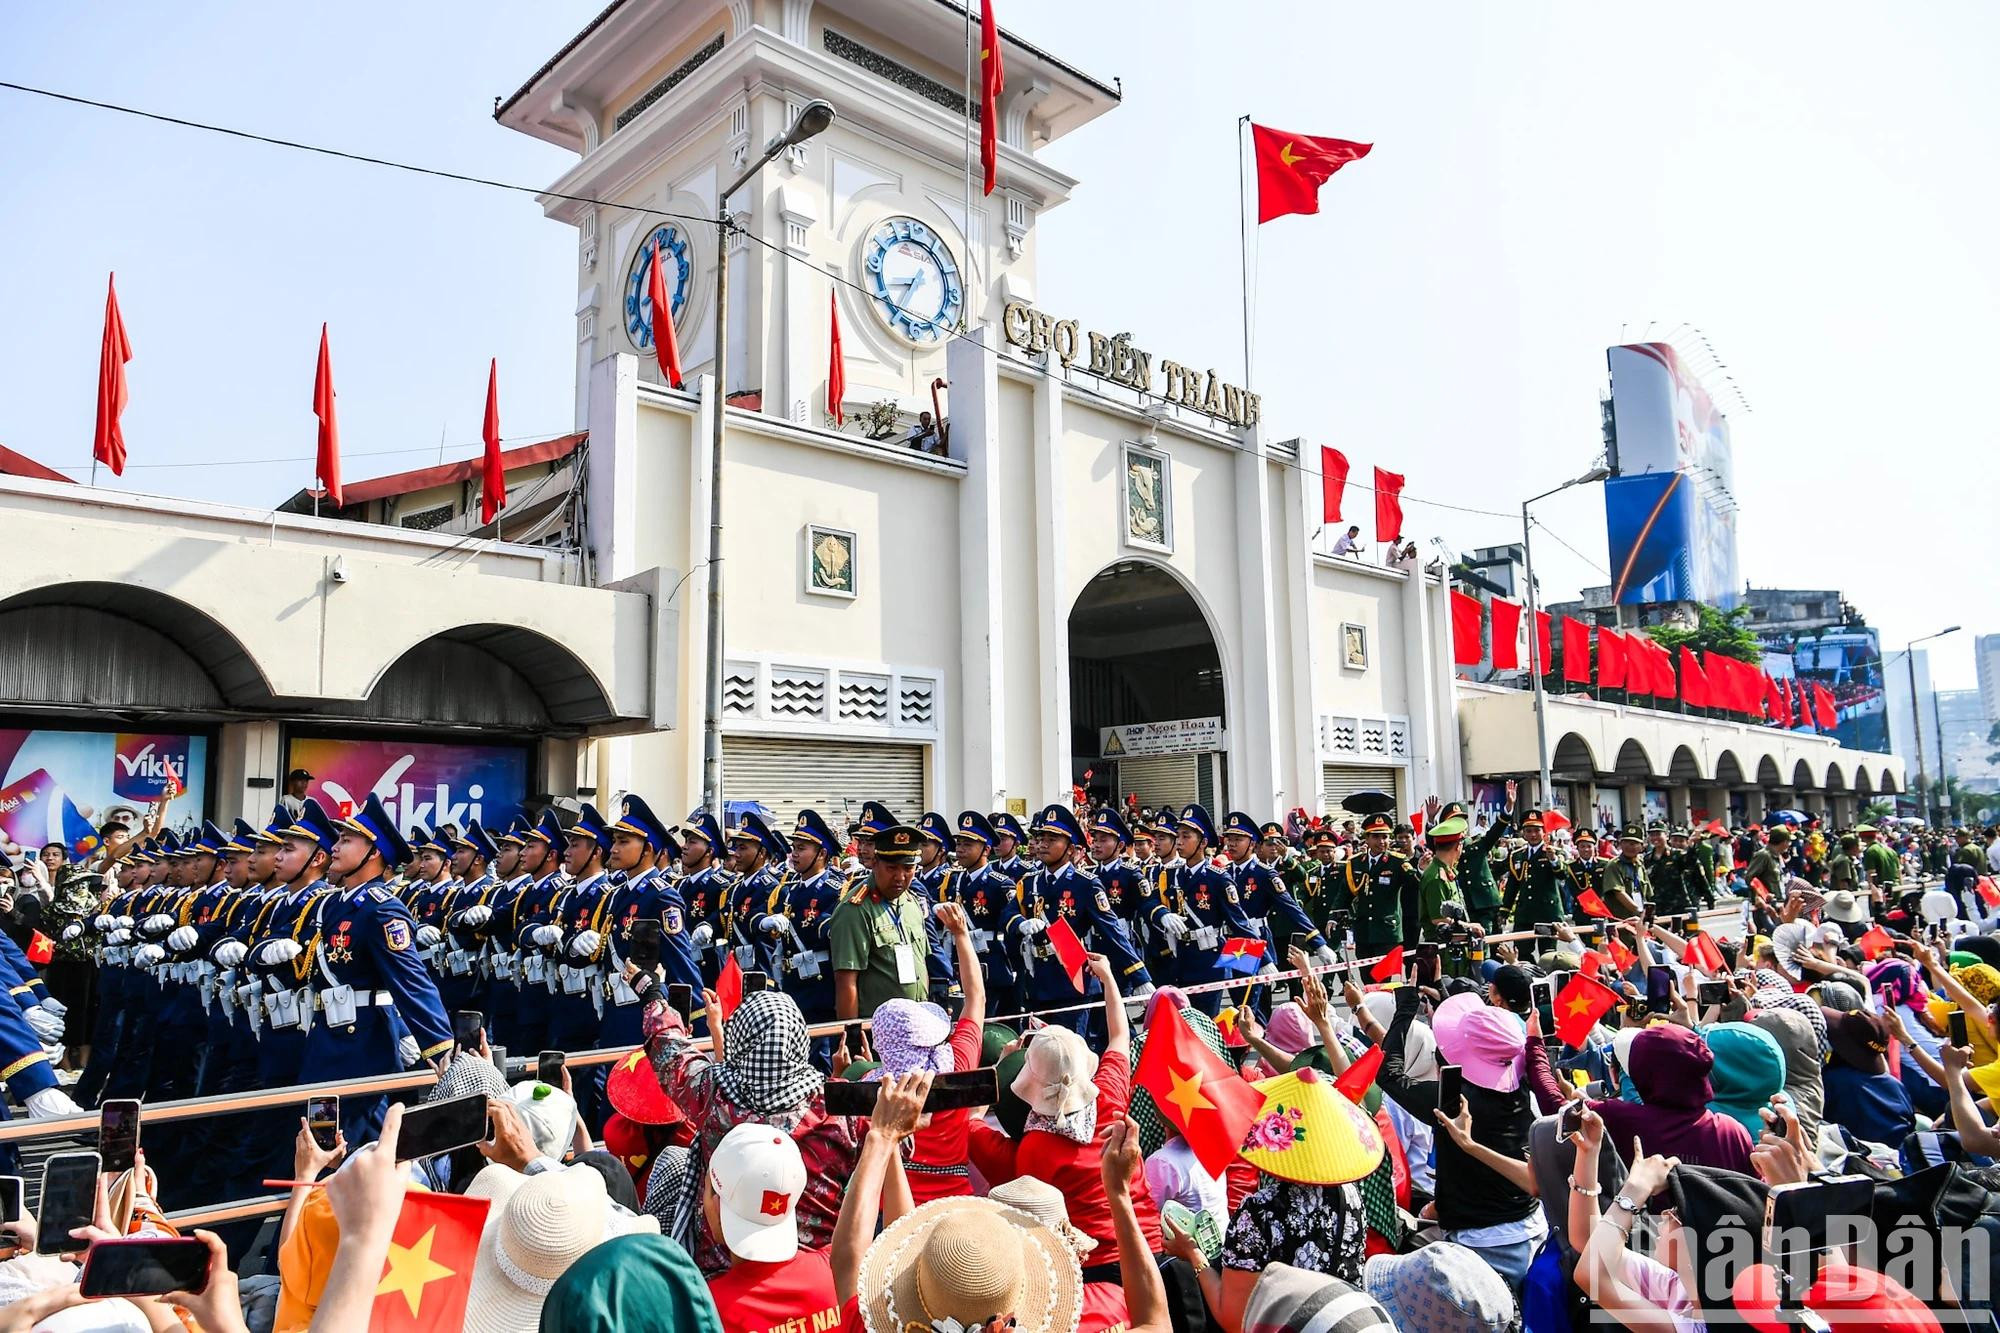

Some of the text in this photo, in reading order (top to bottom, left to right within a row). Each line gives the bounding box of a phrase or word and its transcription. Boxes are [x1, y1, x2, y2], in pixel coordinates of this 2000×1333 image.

[1003, 301, 1262, 427] CHỢ BẾN THÀNH
[1181, 720, 1206, 731] Hoa
[116, 743, 185, 777] Vikki
[812, 1304, 842, 1333] NA
